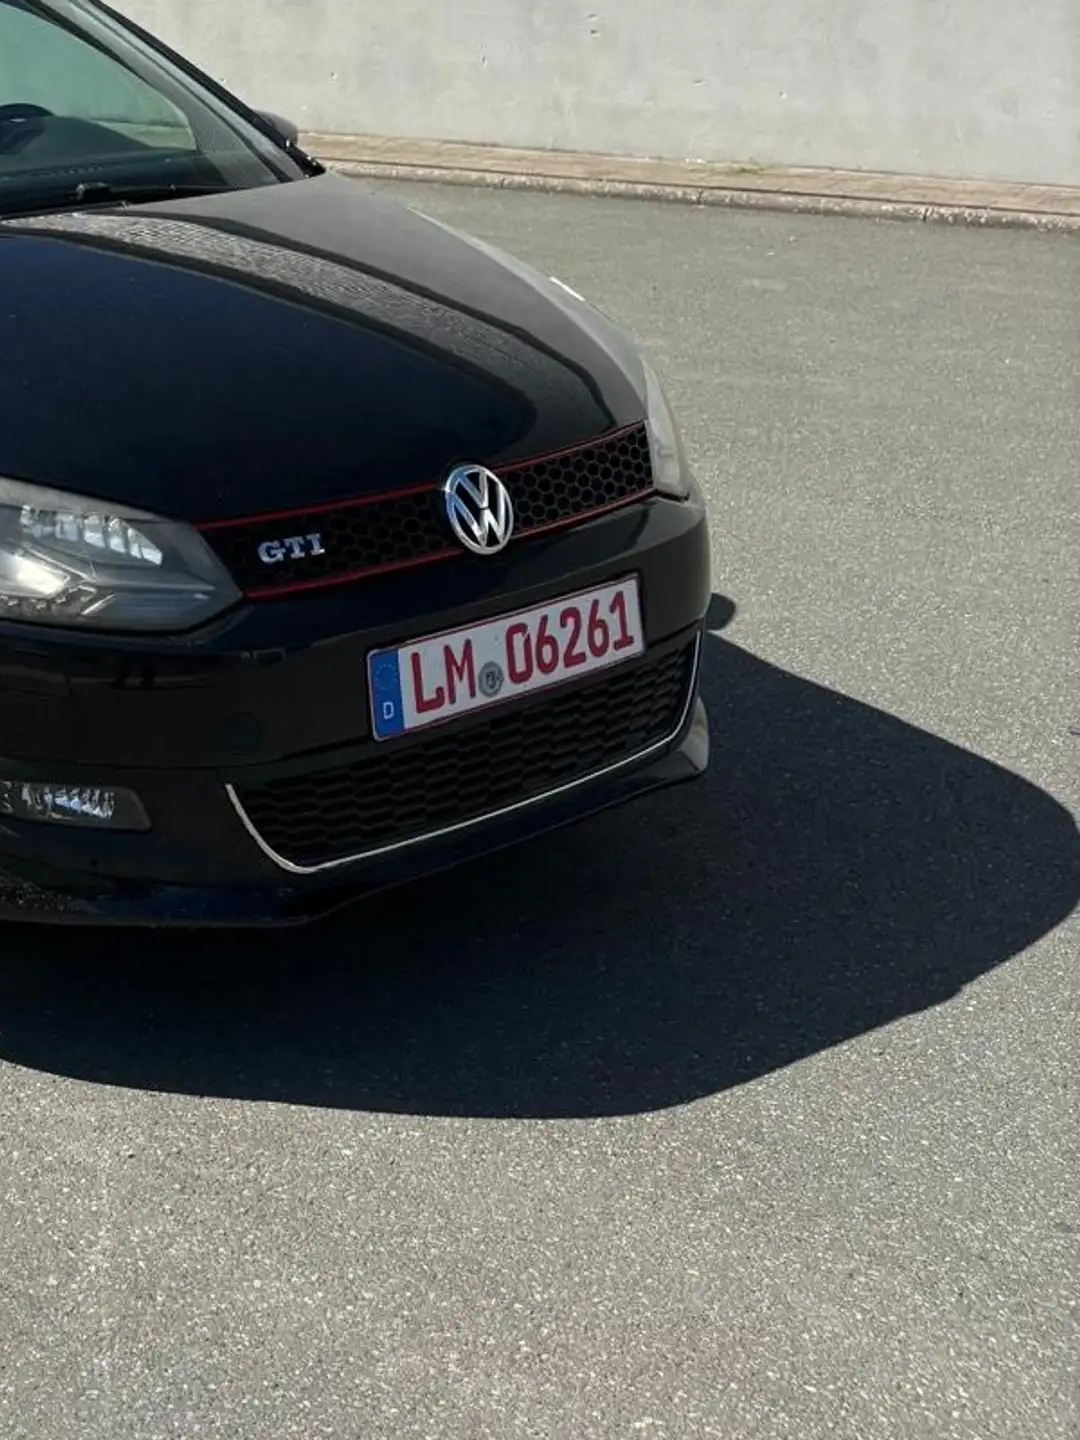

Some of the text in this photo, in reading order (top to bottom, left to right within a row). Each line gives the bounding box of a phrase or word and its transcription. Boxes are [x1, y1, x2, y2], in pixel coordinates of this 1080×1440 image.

[258, 533, 325, 564] GTI
[446, 465, 512, 555] VW
[382, 590, 635, 720] D LM 06261
